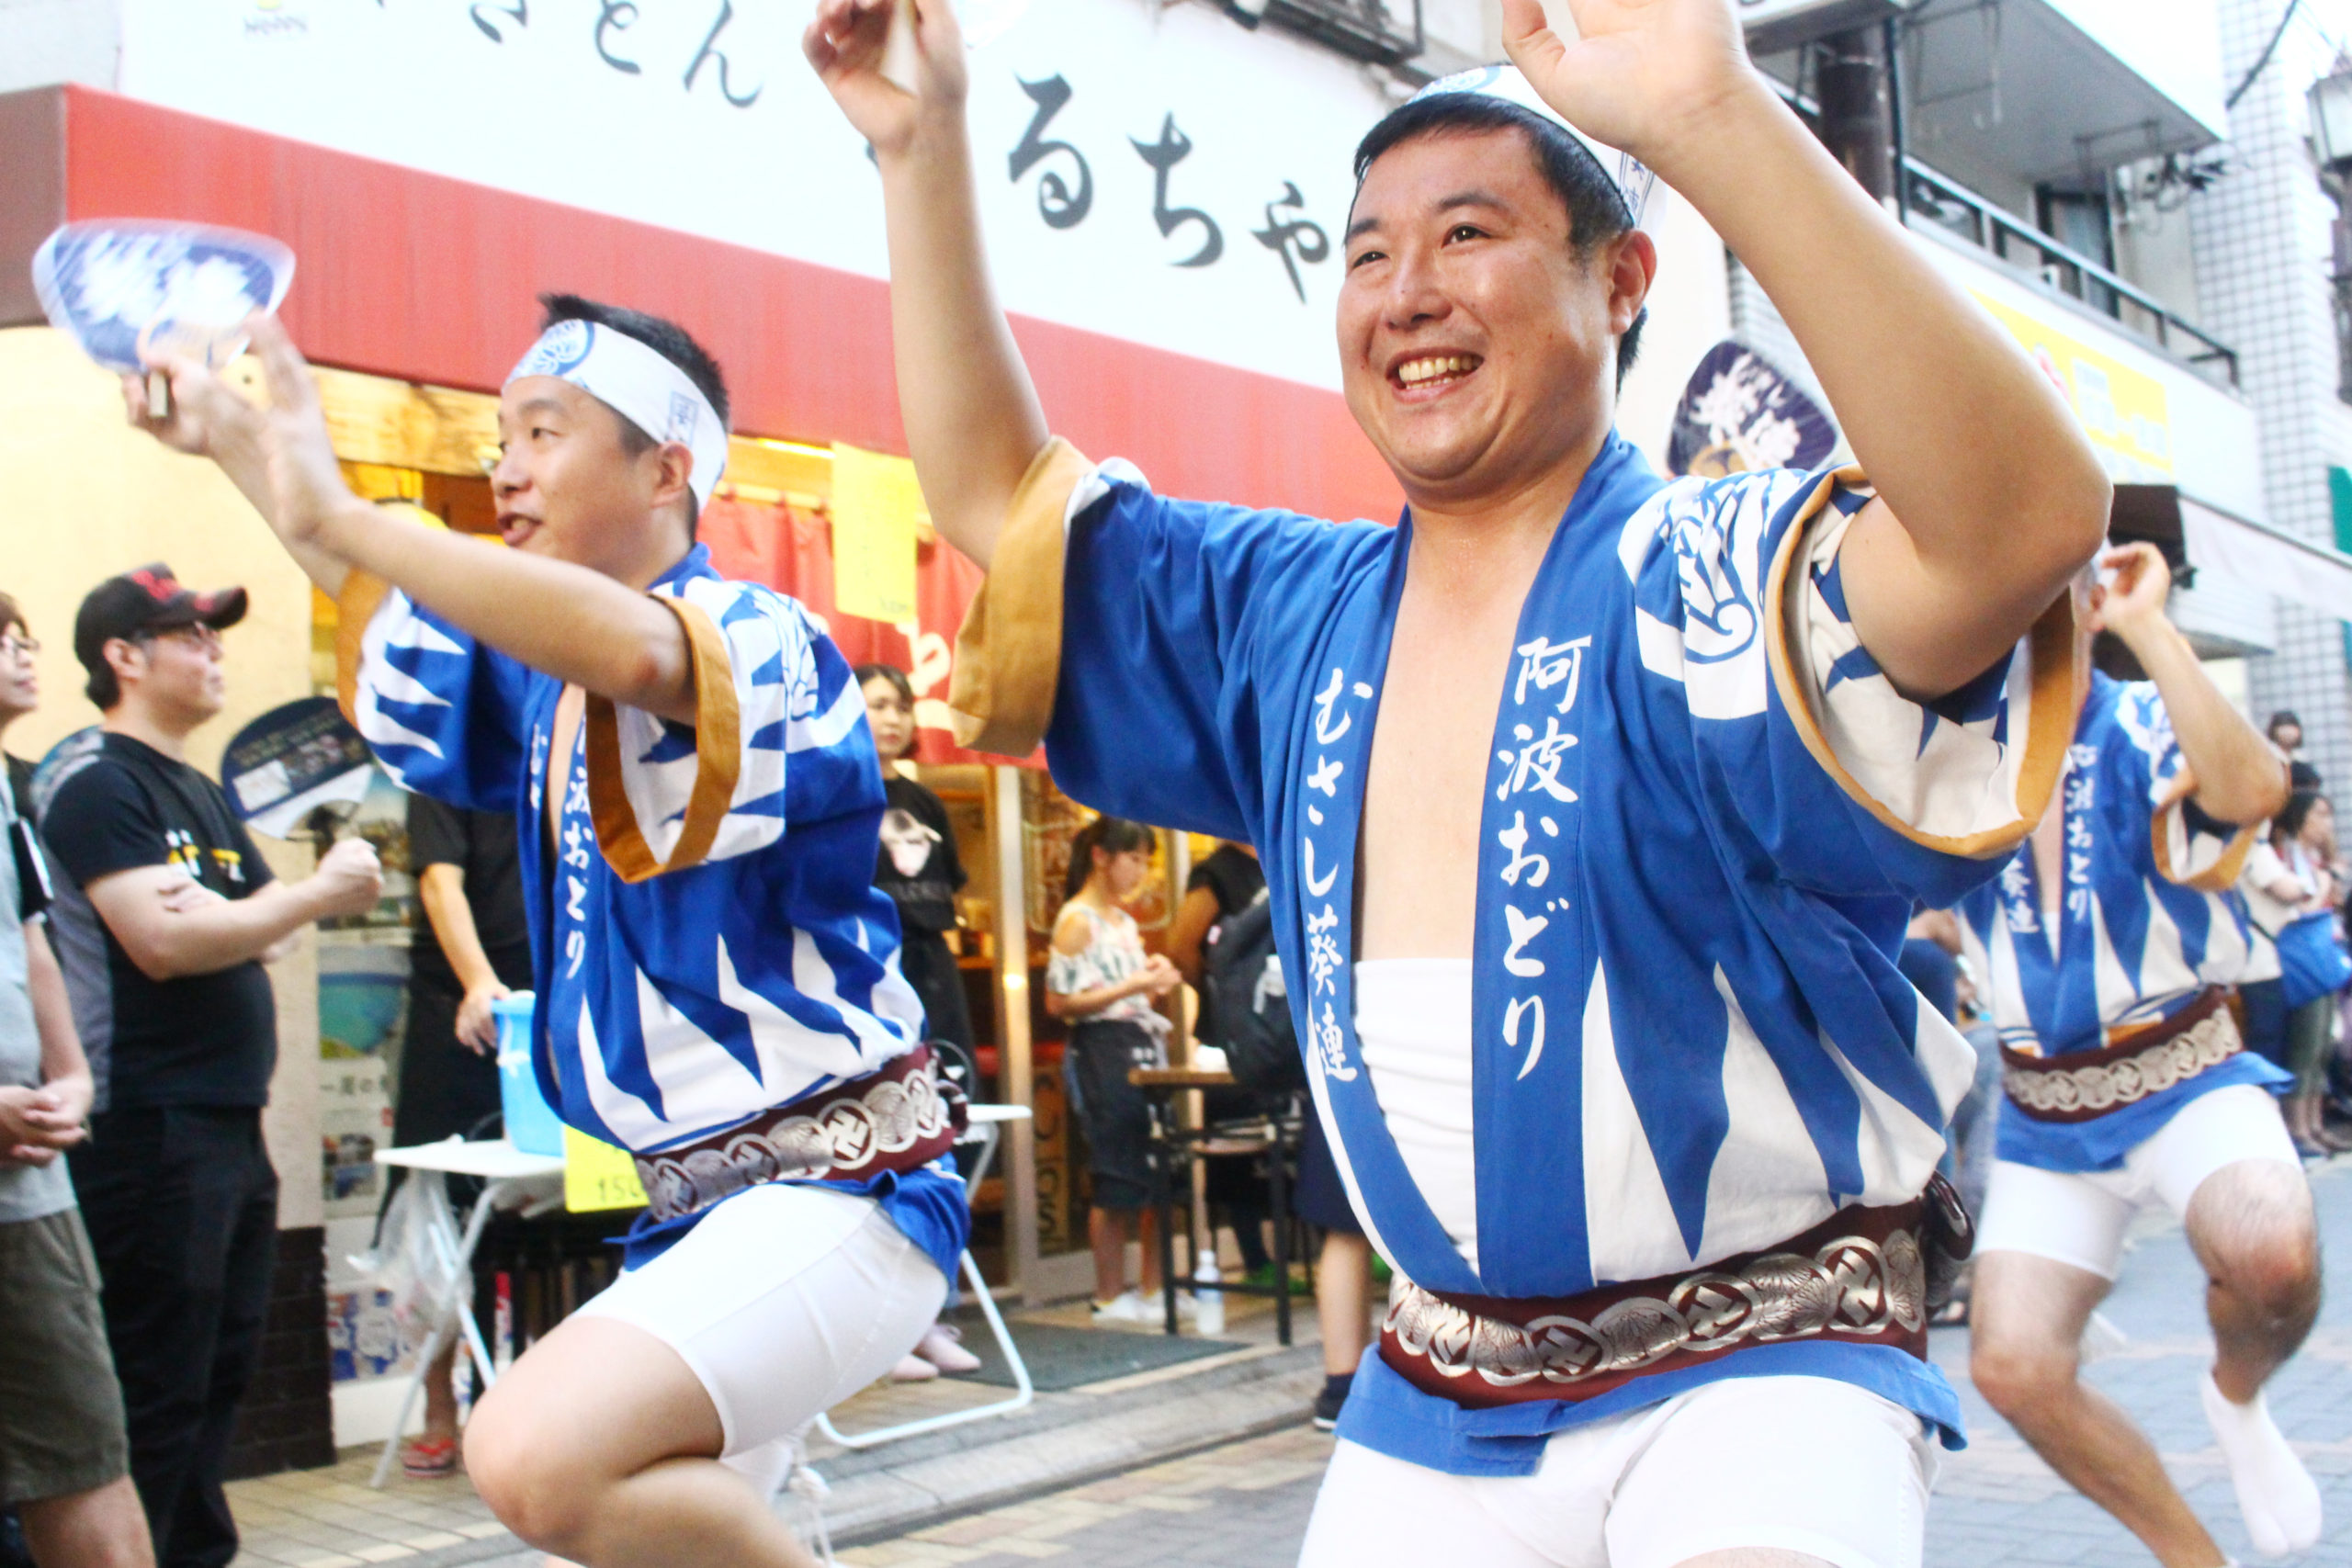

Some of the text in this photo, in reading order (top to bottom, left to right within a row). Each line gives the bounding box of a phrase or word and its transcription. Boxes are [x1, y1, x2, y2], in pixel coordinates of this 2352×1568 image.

[866, 72, 1329, 305] るちゃ
[1304, 667, 1374, 1082] むさし葵連
[1497, 634, 1592, 1081] 阿波おどり
